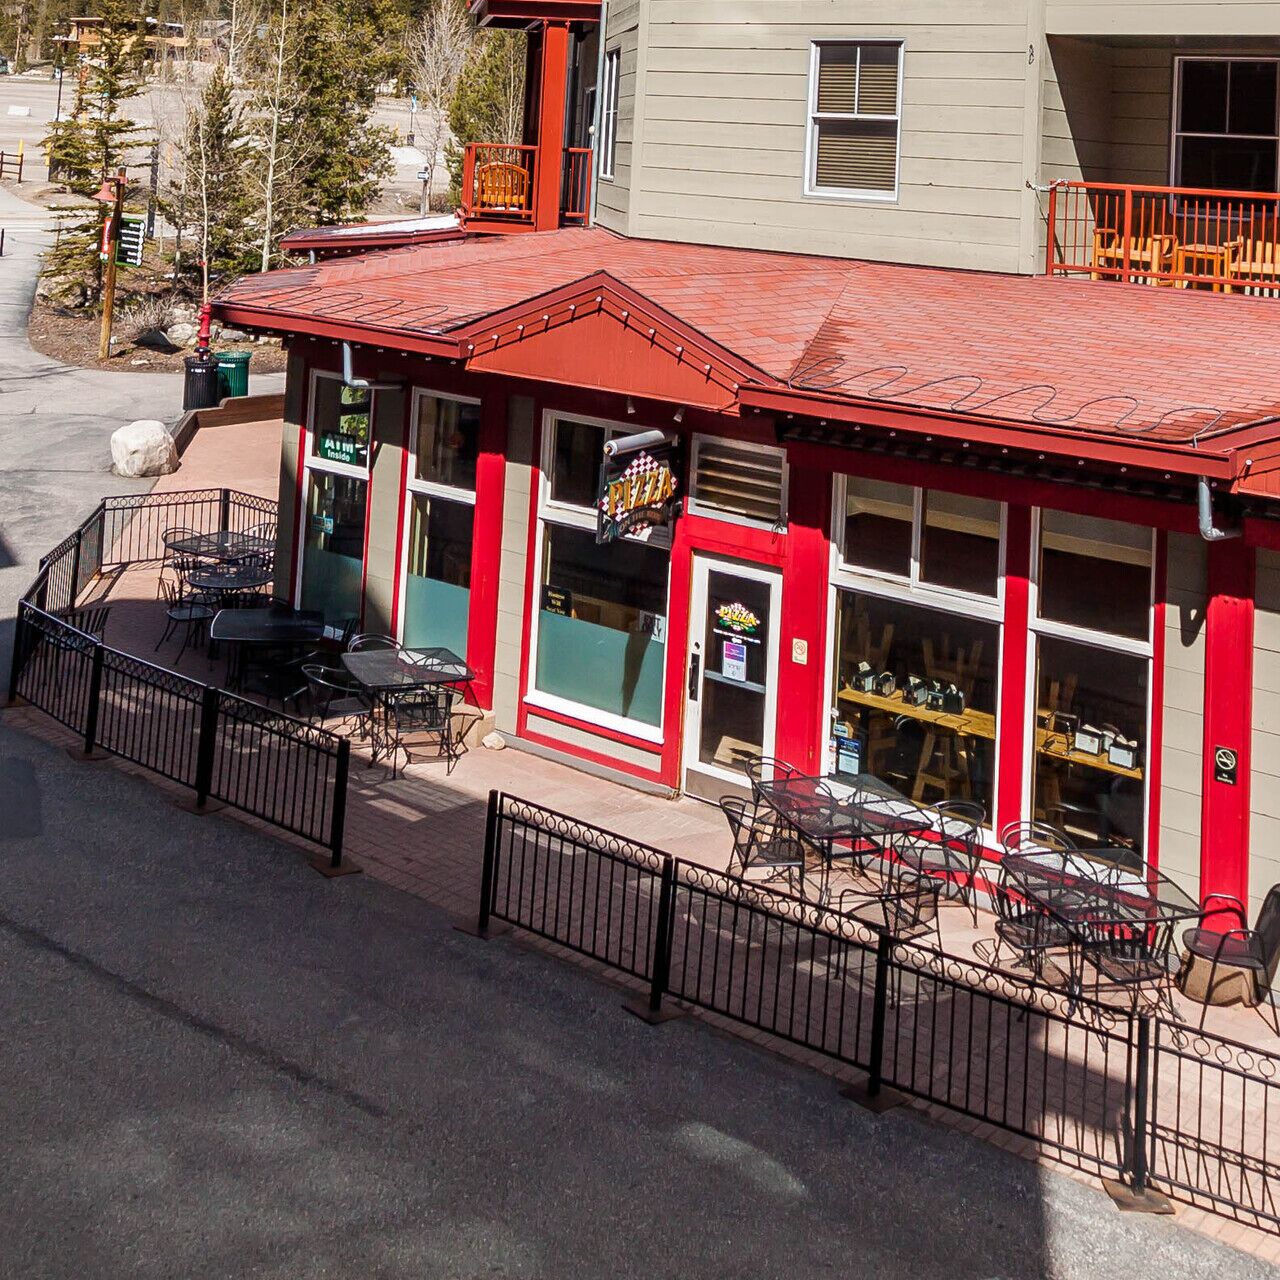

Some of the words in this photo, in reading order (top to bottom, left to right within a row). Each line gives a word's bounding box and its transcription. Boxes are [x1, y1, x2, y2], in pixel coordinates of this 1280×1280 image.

[324, 432, 354, 454] ATM
[327, 449, 351, 462] Inside
[608, 467, 674, 516] PIZZA
[719, 605, 757, 626] PIZZA
